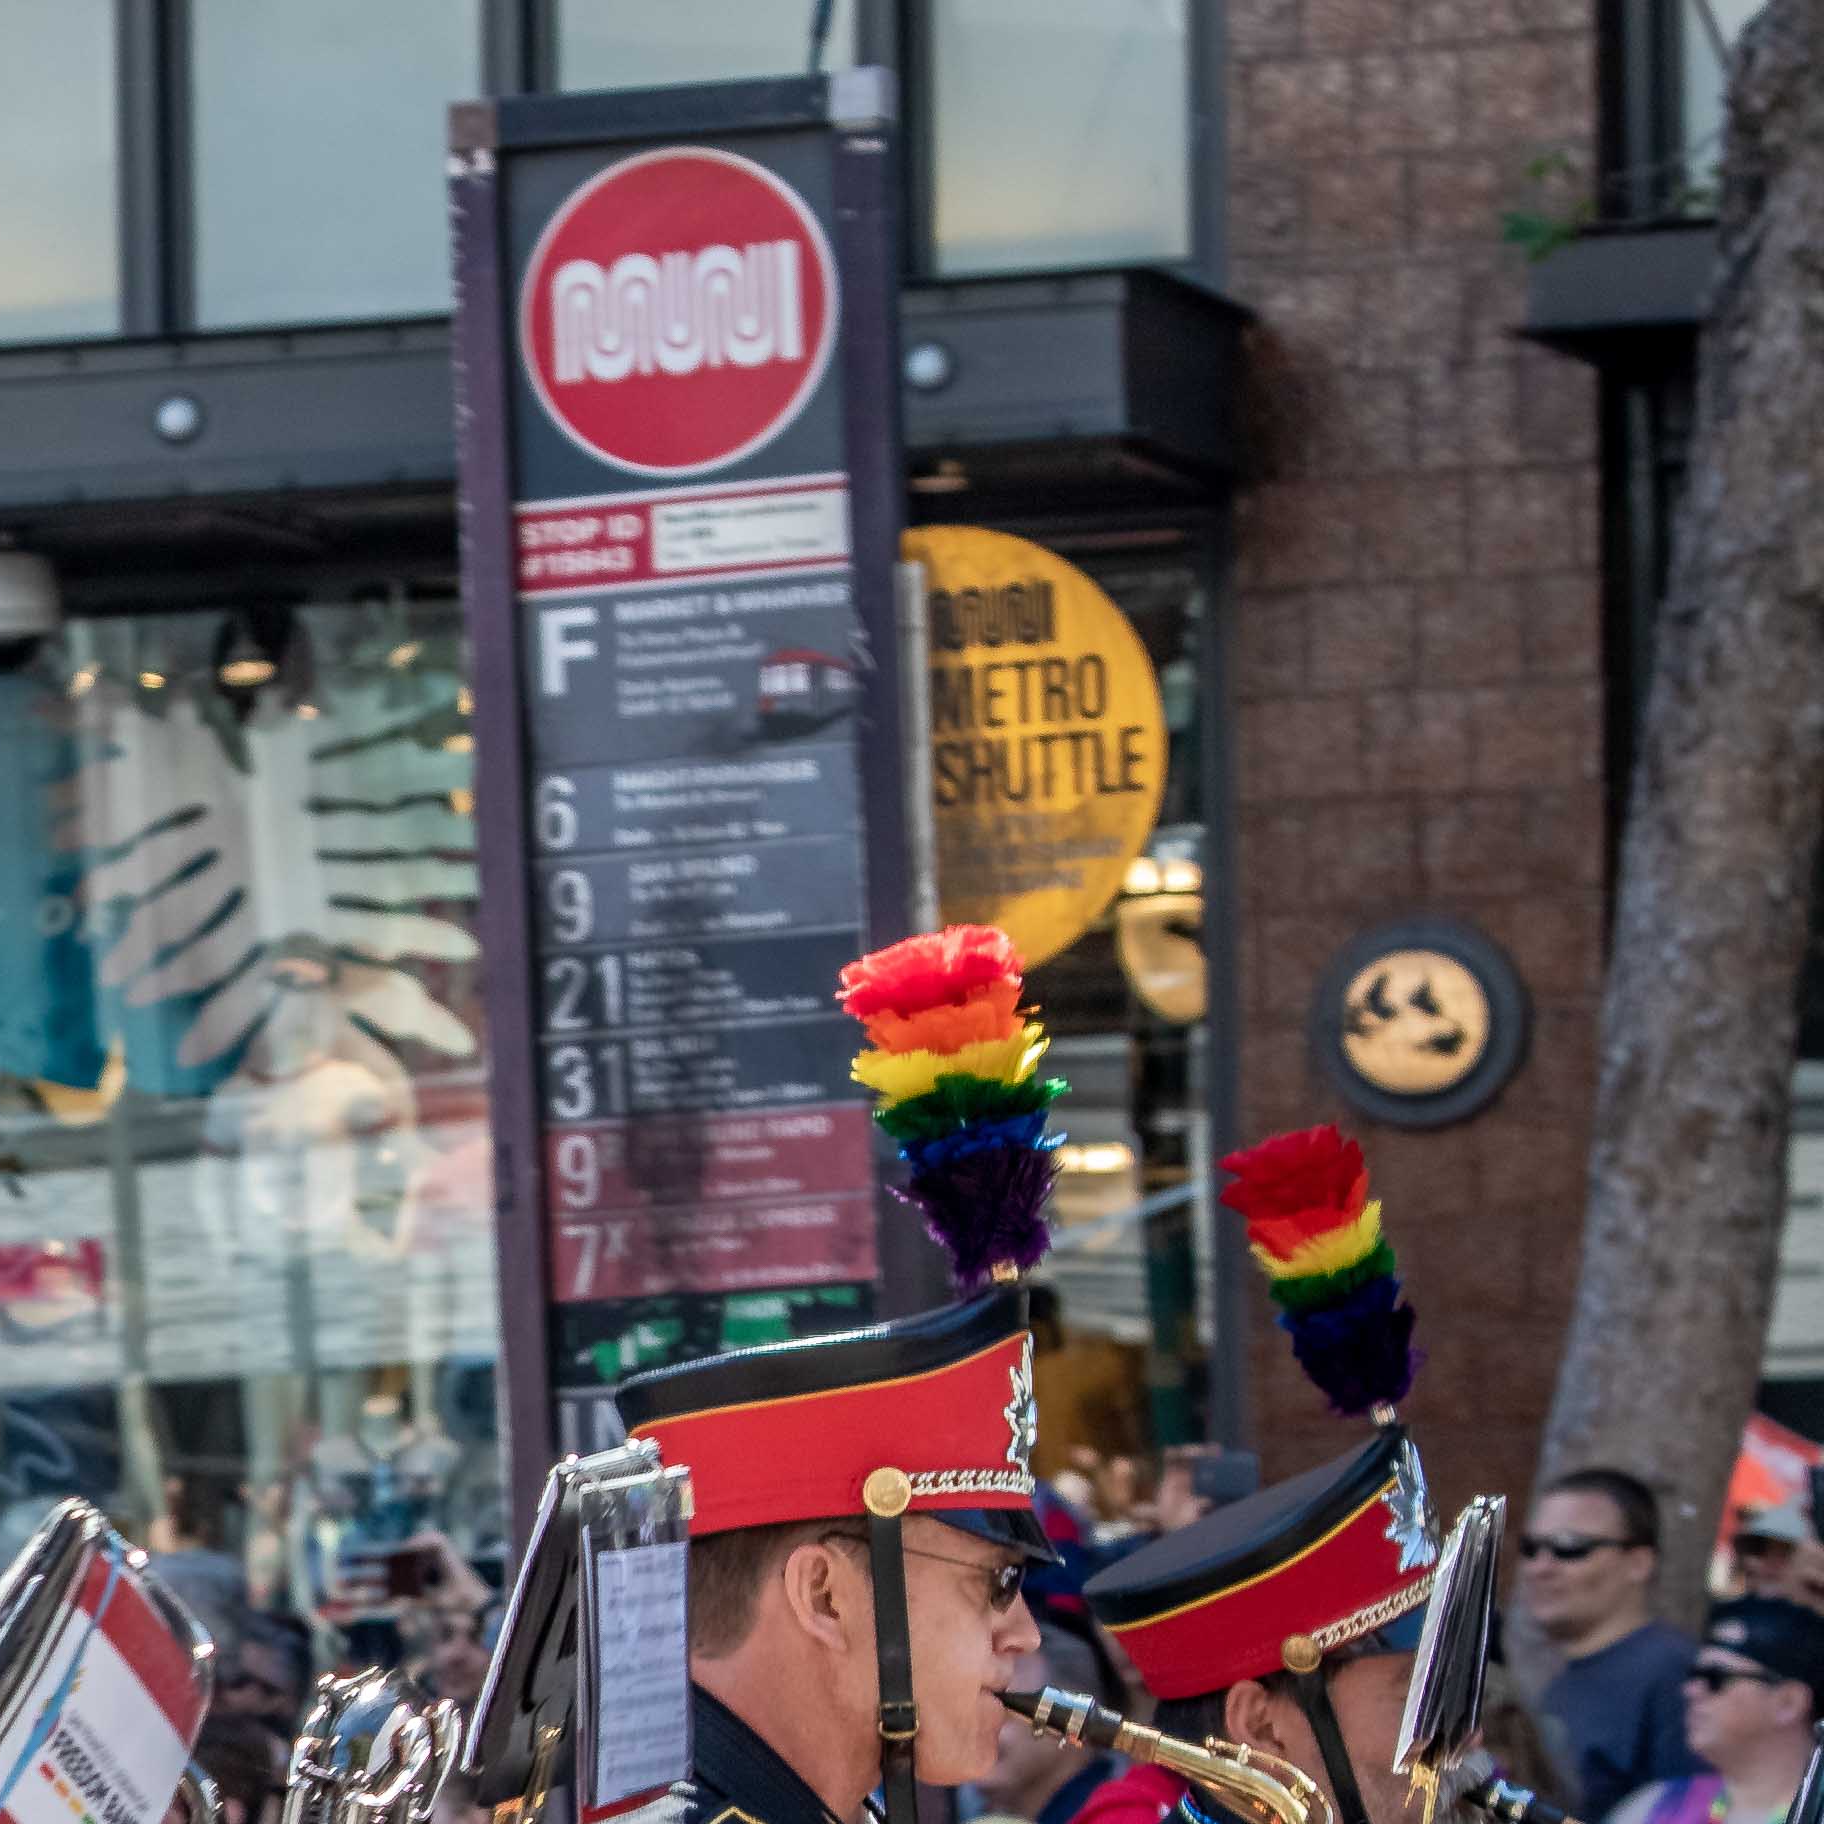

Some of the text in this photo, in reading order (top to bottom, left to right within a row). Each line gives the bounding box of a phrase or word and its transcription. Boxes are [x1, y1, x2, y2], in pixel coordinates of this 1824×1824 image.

[540, 606, 599, 696] F
[929, 653, 1108, 737] METRO
[933, 725, 1145, 806] SHUTTLE
[536, 774, 579, 849] 6
[551, 869, 593, 943] 9
[547, 953, 624, 1029] 21
[551, 1045, 625, 1118] 31
